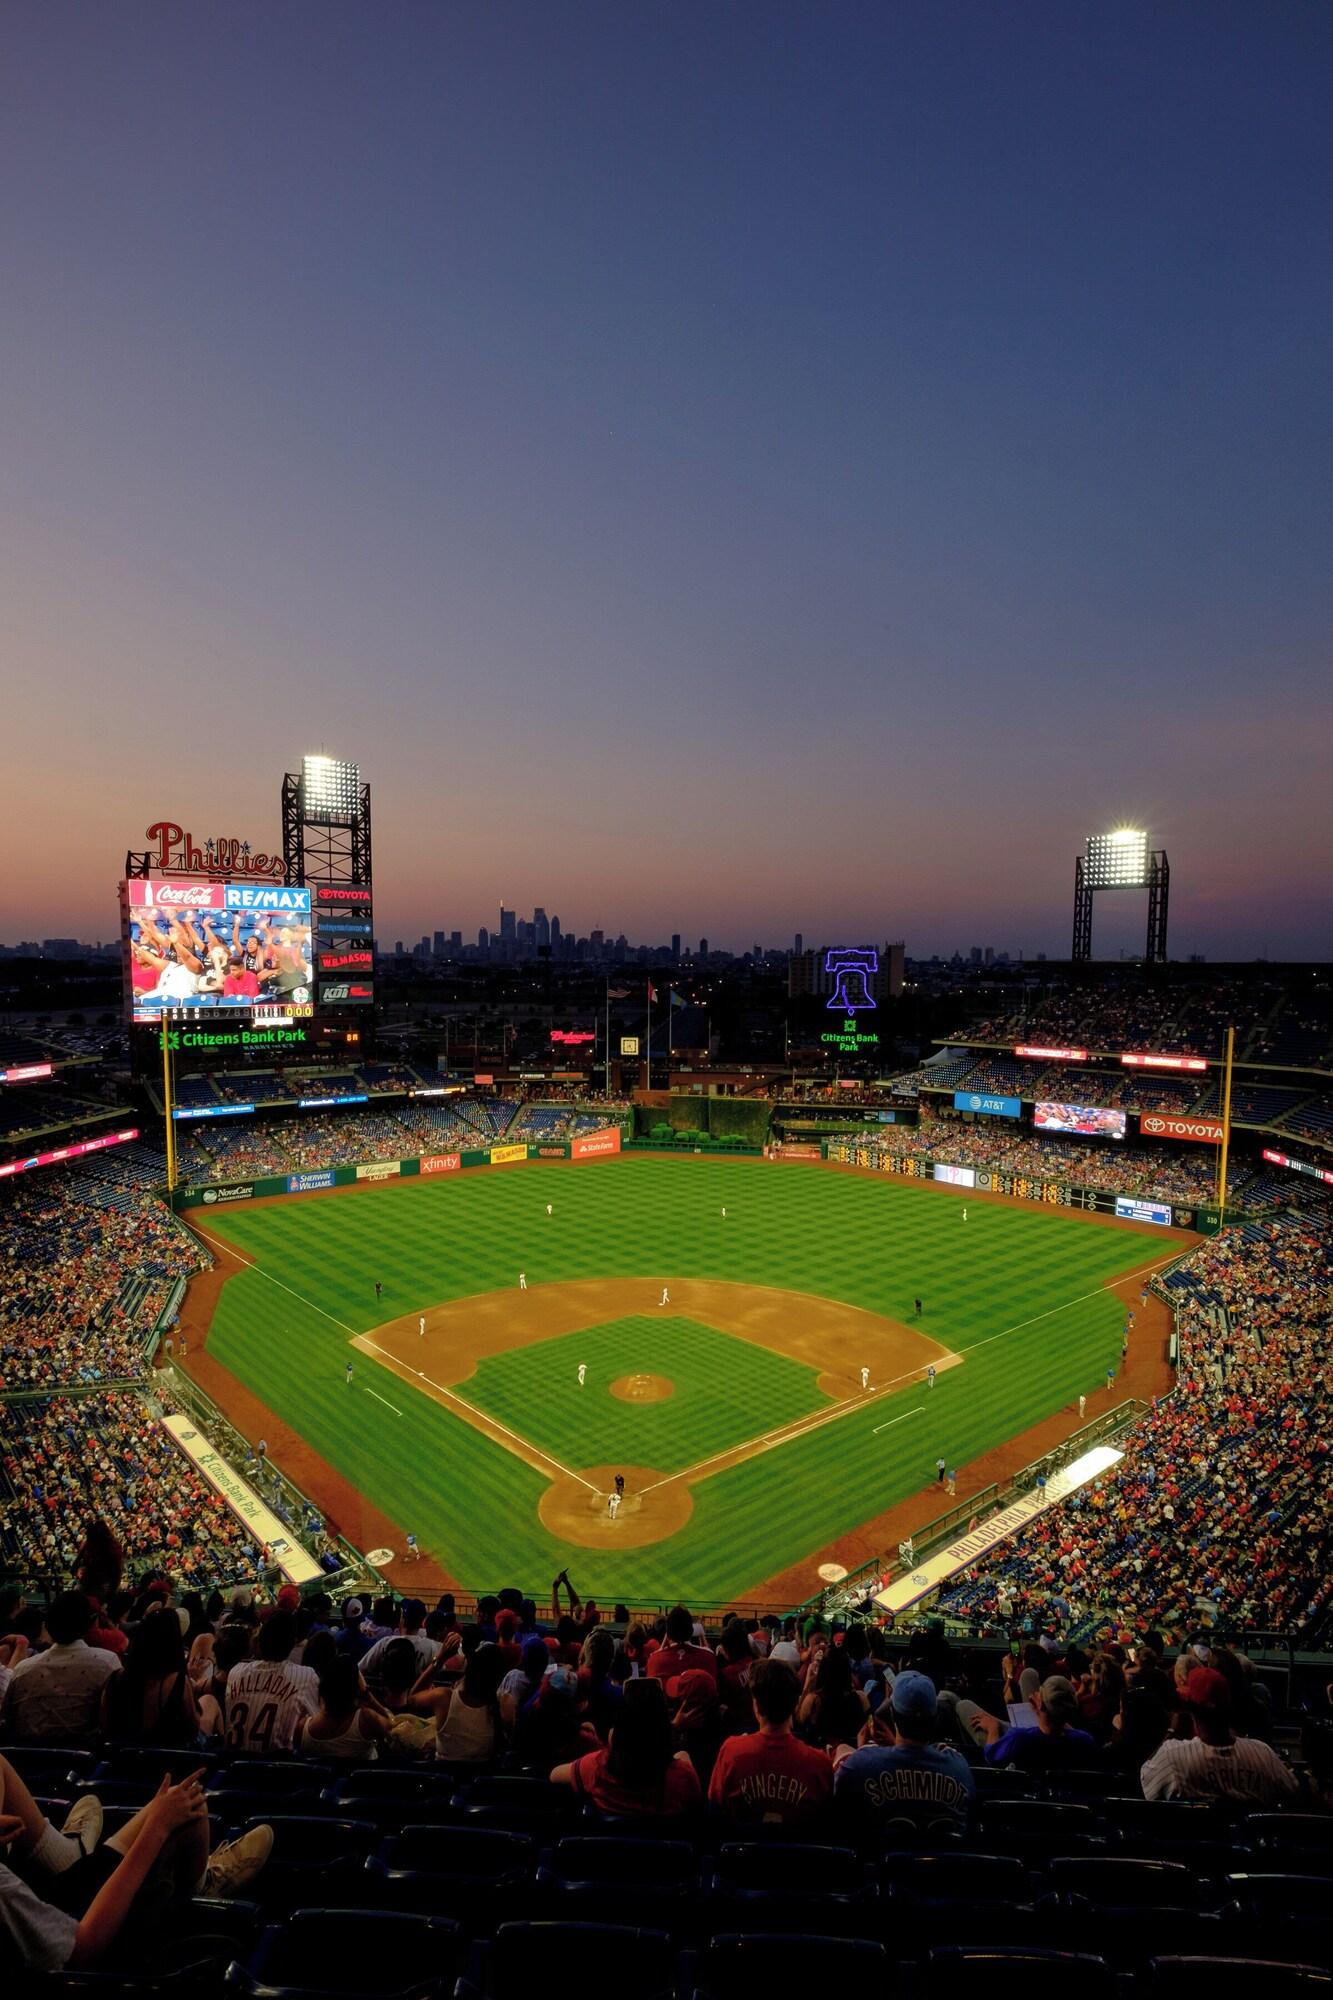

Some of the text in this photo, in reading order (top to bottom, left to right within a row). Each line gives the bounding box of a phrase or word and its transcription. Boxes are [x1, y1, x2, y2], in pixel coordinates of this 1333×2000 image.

[146, 822, 288, 876] Phillies
[156, 885, 214, 905] Coca-Cola
[227, 889, 306, 908] RE/MAX
[332, 890, 370, 900] TOYOTA
[213, 1010, 220, 1018] 6
[225, 1009, 231, 1017] 7
[234, 1008, 241, 1017] 8
[286, 1007, 293, 1017] 0
[295, 1007, 303, 1017] 0
[304, 1007, 312, 1017] 0
[182, 1028, 306, 1046] Citizens Bank Park
[821, 1033, 879, 1042] Citizens Bank
[840, 1042, 859, 1051] Park
[983, 1100, 1005, 1111] AT&T
[1167, 1121, 1224, 1139] TOYOTA
[423, 1157, 458, 1172] xfinity
[300, 1172, 331, 1183] SHERWIN
[300, 1180, 333, 1191] WILLIAMS
[218, 1186, 254, 1198] NovaCare
[208, 1462, 262, 1519] Citizens Bank Park
[947, 1507, 1031, 1562] PHILADELPHIA
[230, 1673, 299, 1703] HALLADAY
[227, 1702, 280, 1750] 34
[740, 1772, 809, 1806] KINGERY
[864, 1769, 969, 1808] SCHMIDT
